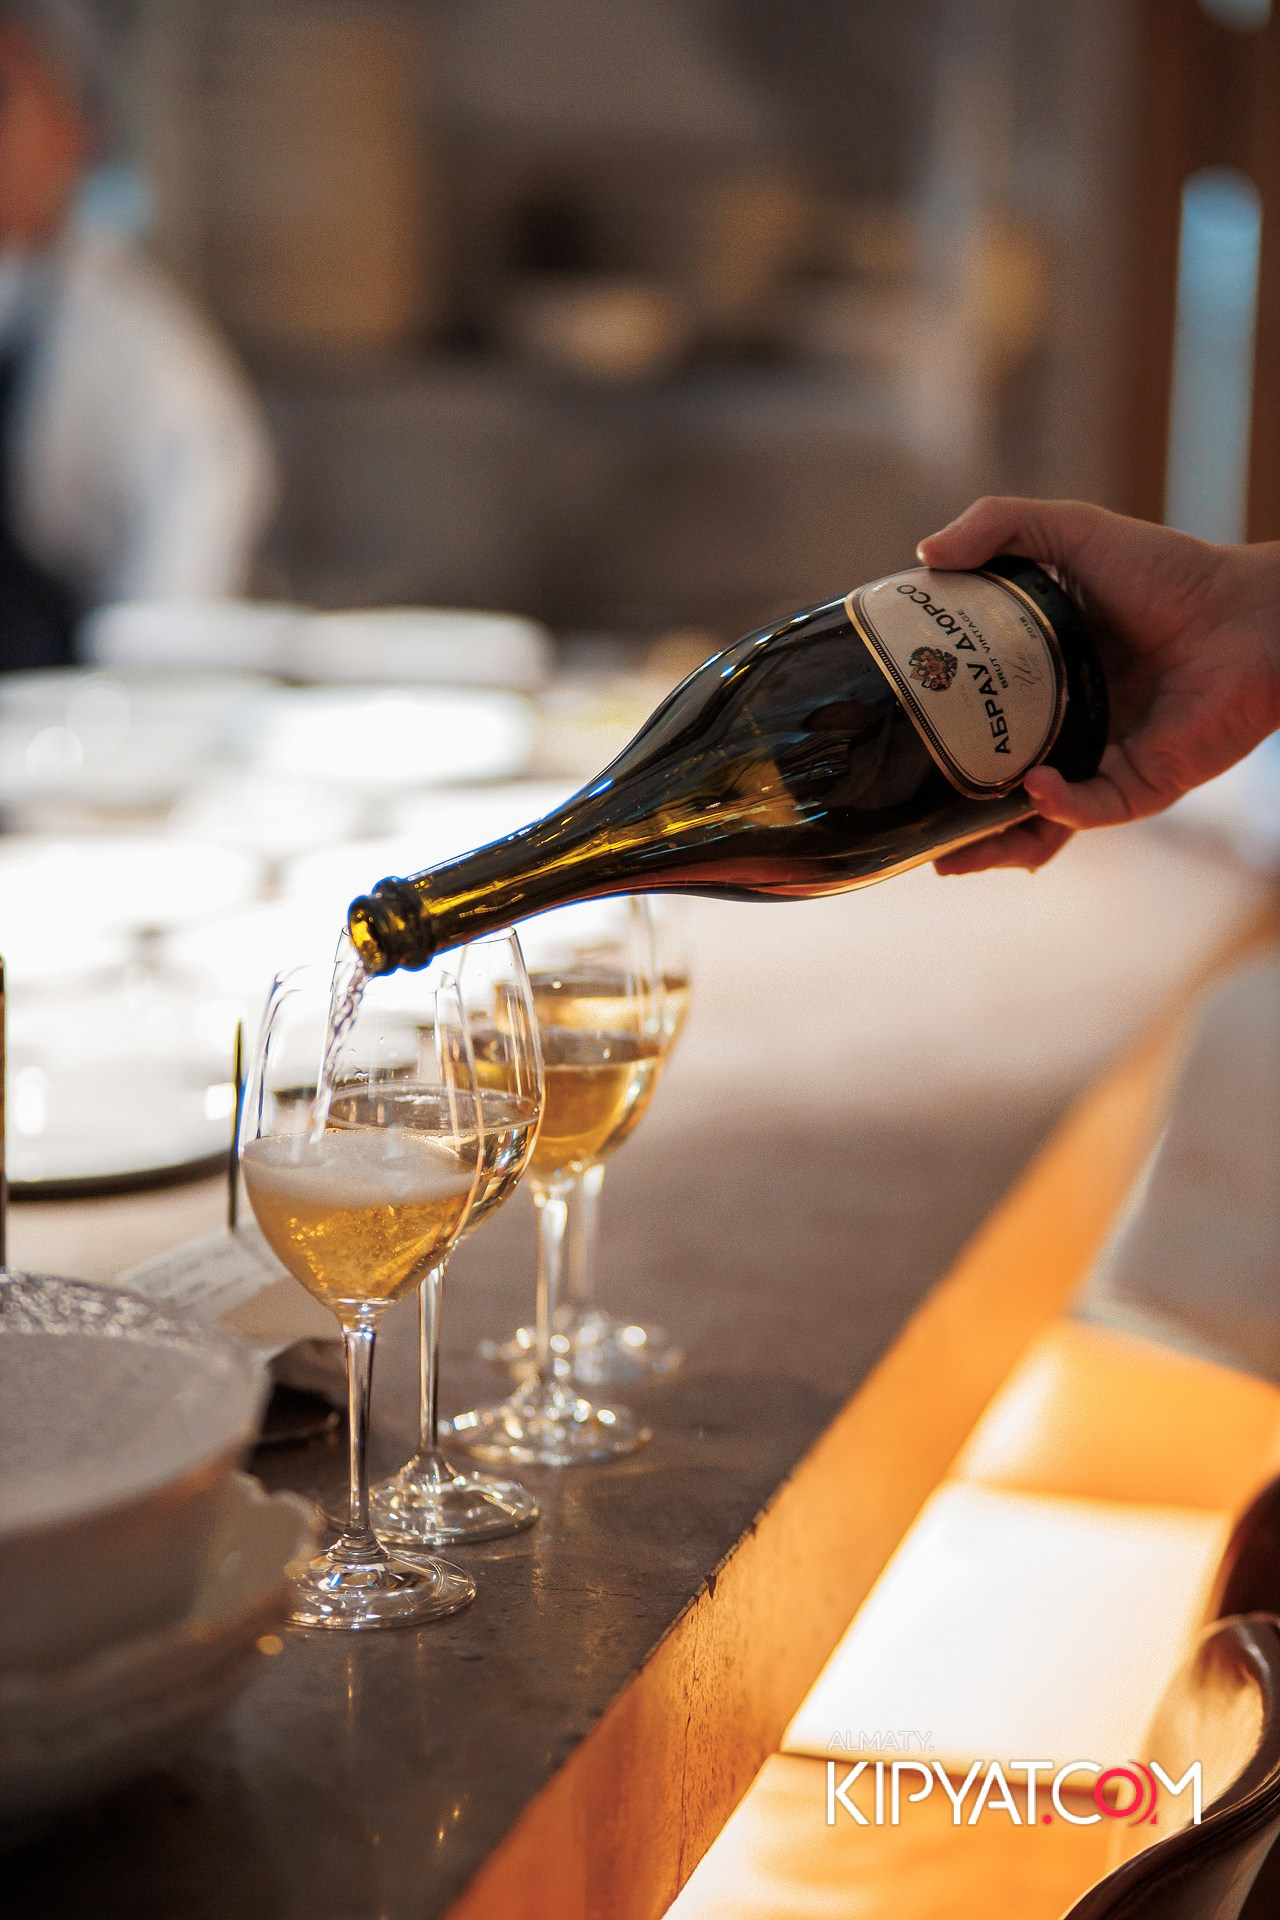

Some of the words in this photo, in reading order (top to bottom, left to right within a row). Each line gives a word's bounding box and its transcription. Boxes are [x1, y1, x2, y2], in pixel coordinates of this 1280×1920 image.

[896, 584, 977, 652] ДЮРСО
[955, 609, 992, 654] VINTAGE
[990, 658, 1009, 689] BRUT
[967, 663, 1011, 755] АБРАУ
